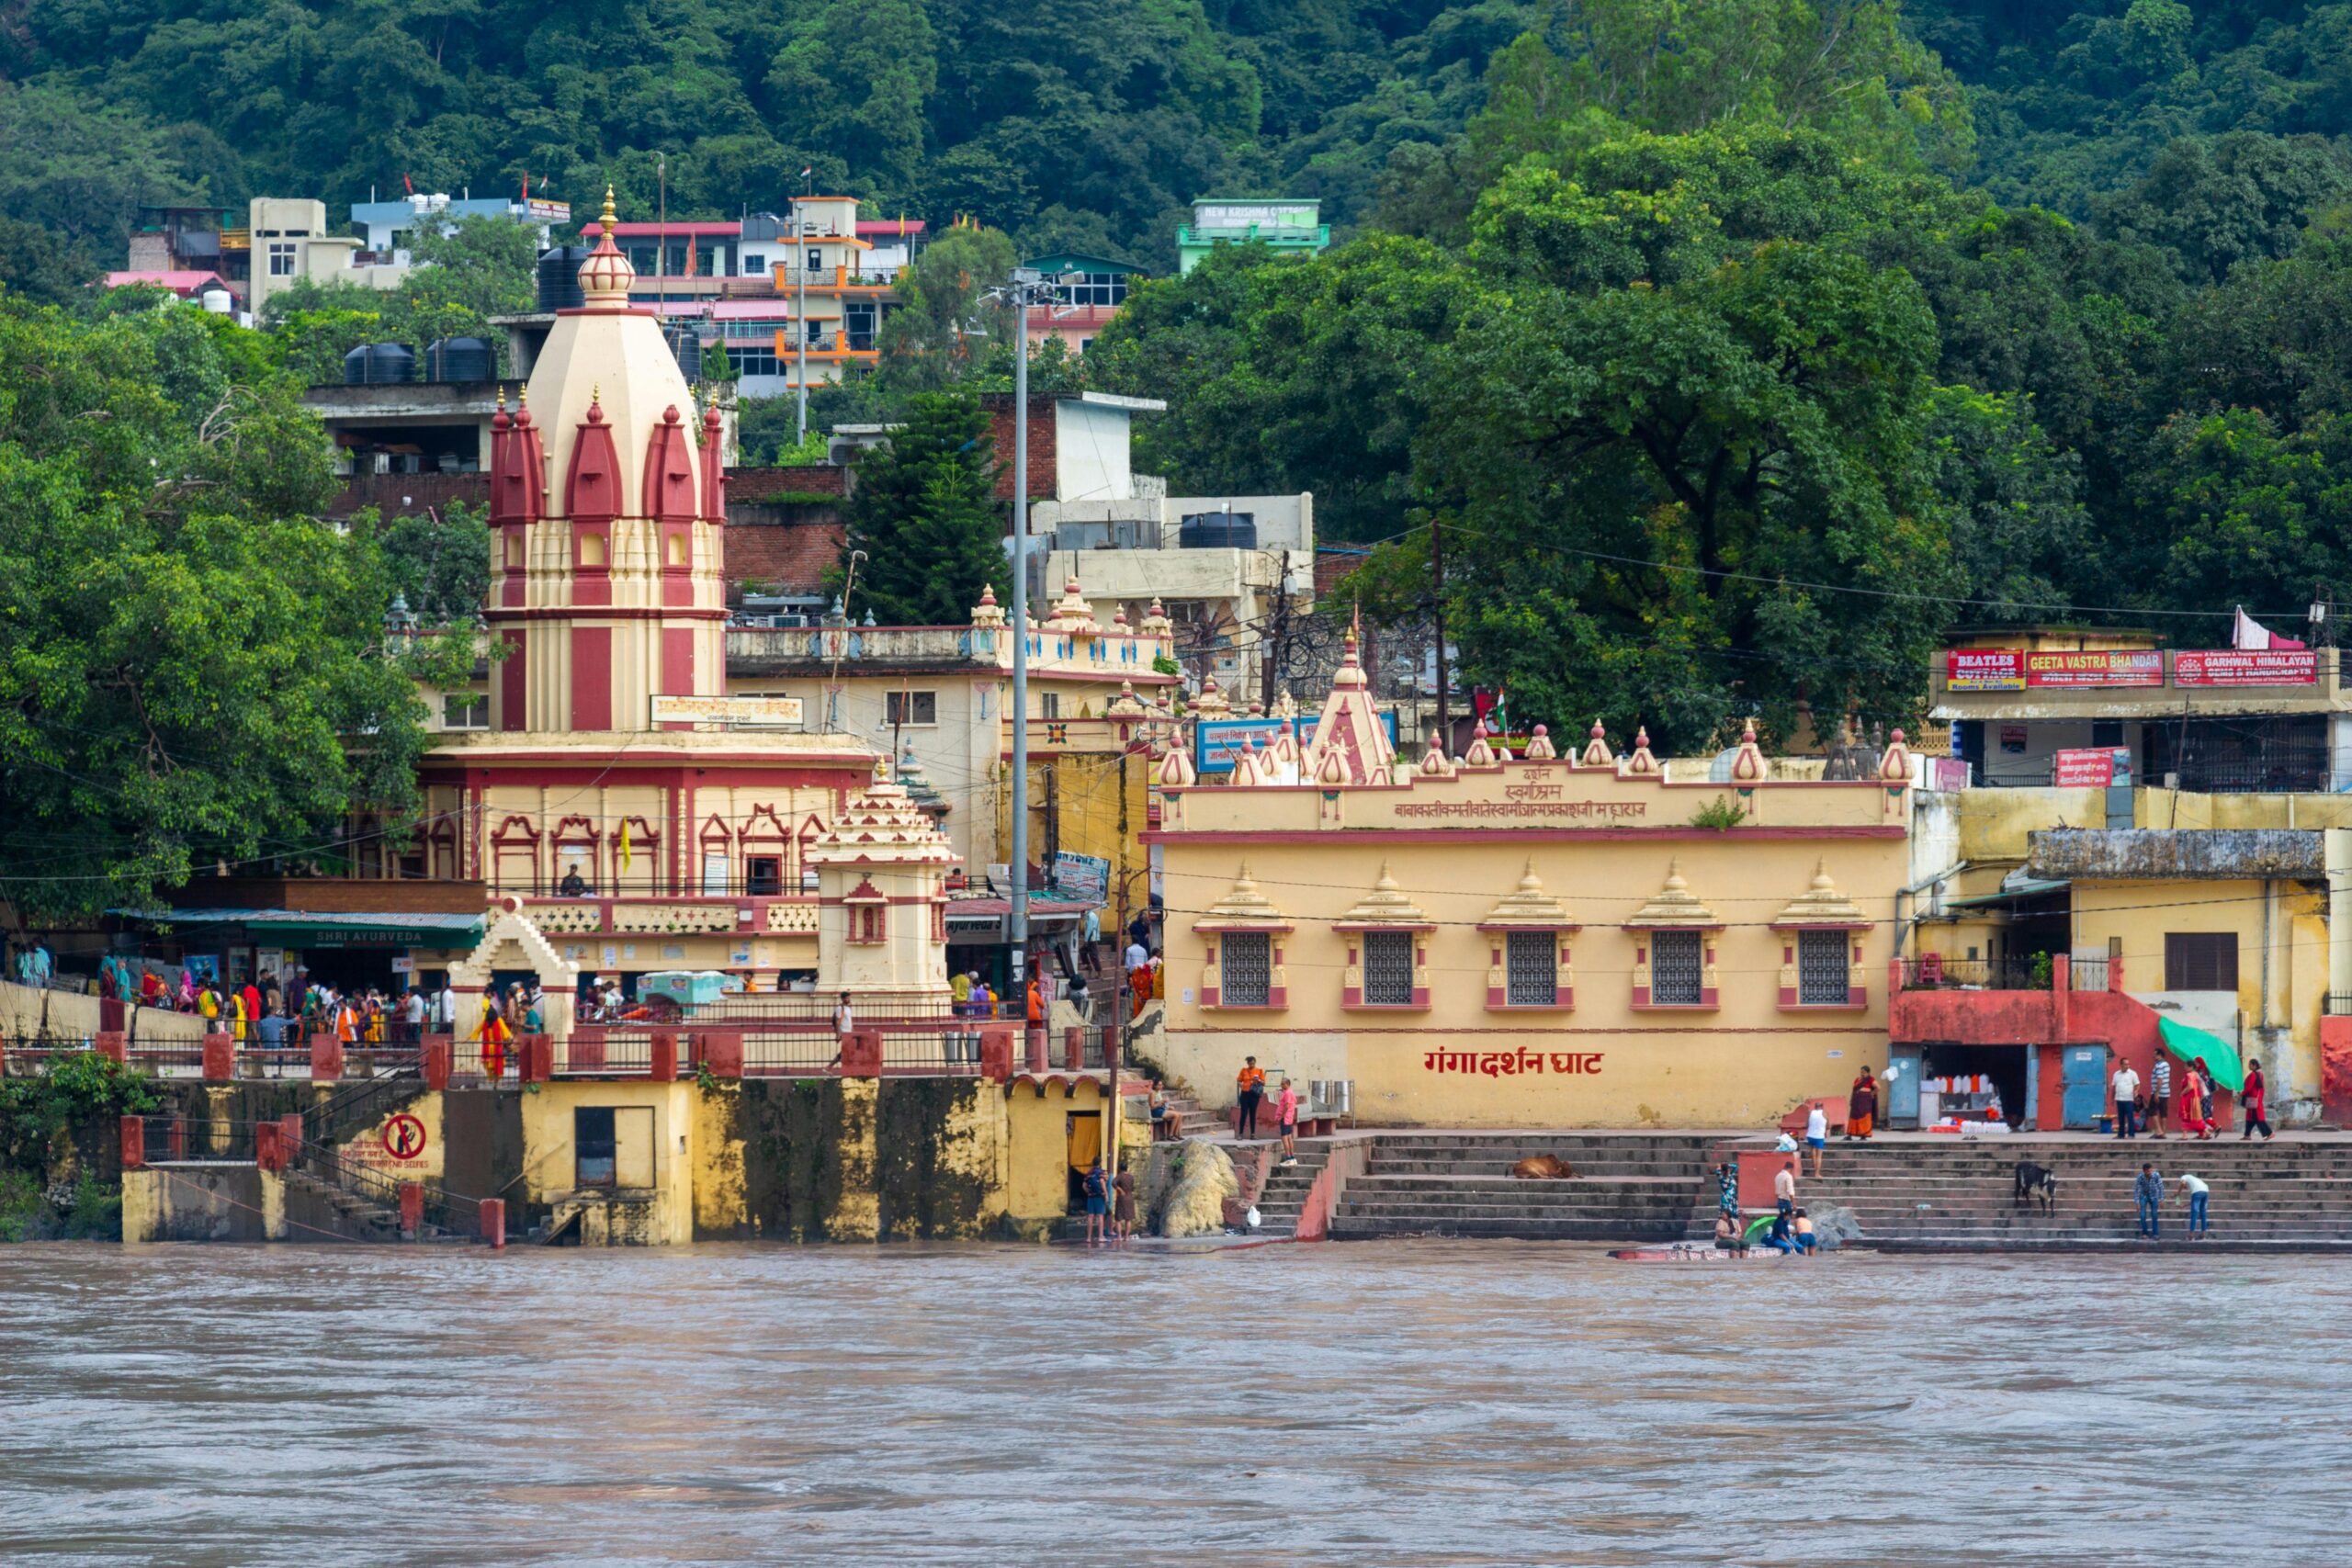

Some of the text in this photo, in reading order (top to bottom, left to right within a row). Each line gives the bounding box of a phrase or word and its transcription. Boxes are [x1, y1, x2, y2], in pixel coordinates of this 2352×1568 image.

[1204, 207, 1225, 217] NEW
[1228, 207, 1268, 217] KRISHNA
[1958, 655, 2015, 667] BEATLES
[2030, 655, 2159, 670] GEETA VASTRA BHANDAR
[2205, 657, 2314, 667] GARHWAL HIMALAYAN
[1956, 668, 2016, 679] COTTAGE
[2208, 669, 2233, 677] GEMS
[2245, 668, 2312, 676] HANDICRAFTS
[1523, 764, 1553, 780] दर्शन
[1505, 781, 1564, 799] स्वर्गाश्रम
[947, 919, 994, 933] Ayurveda
[317, 931, 422, 942] SHRI AYURVEDA
[1424, 1045, 1605, 1078] गंगा दर्शन घाट
[404, 1160, 429, 1168] SELFIES
